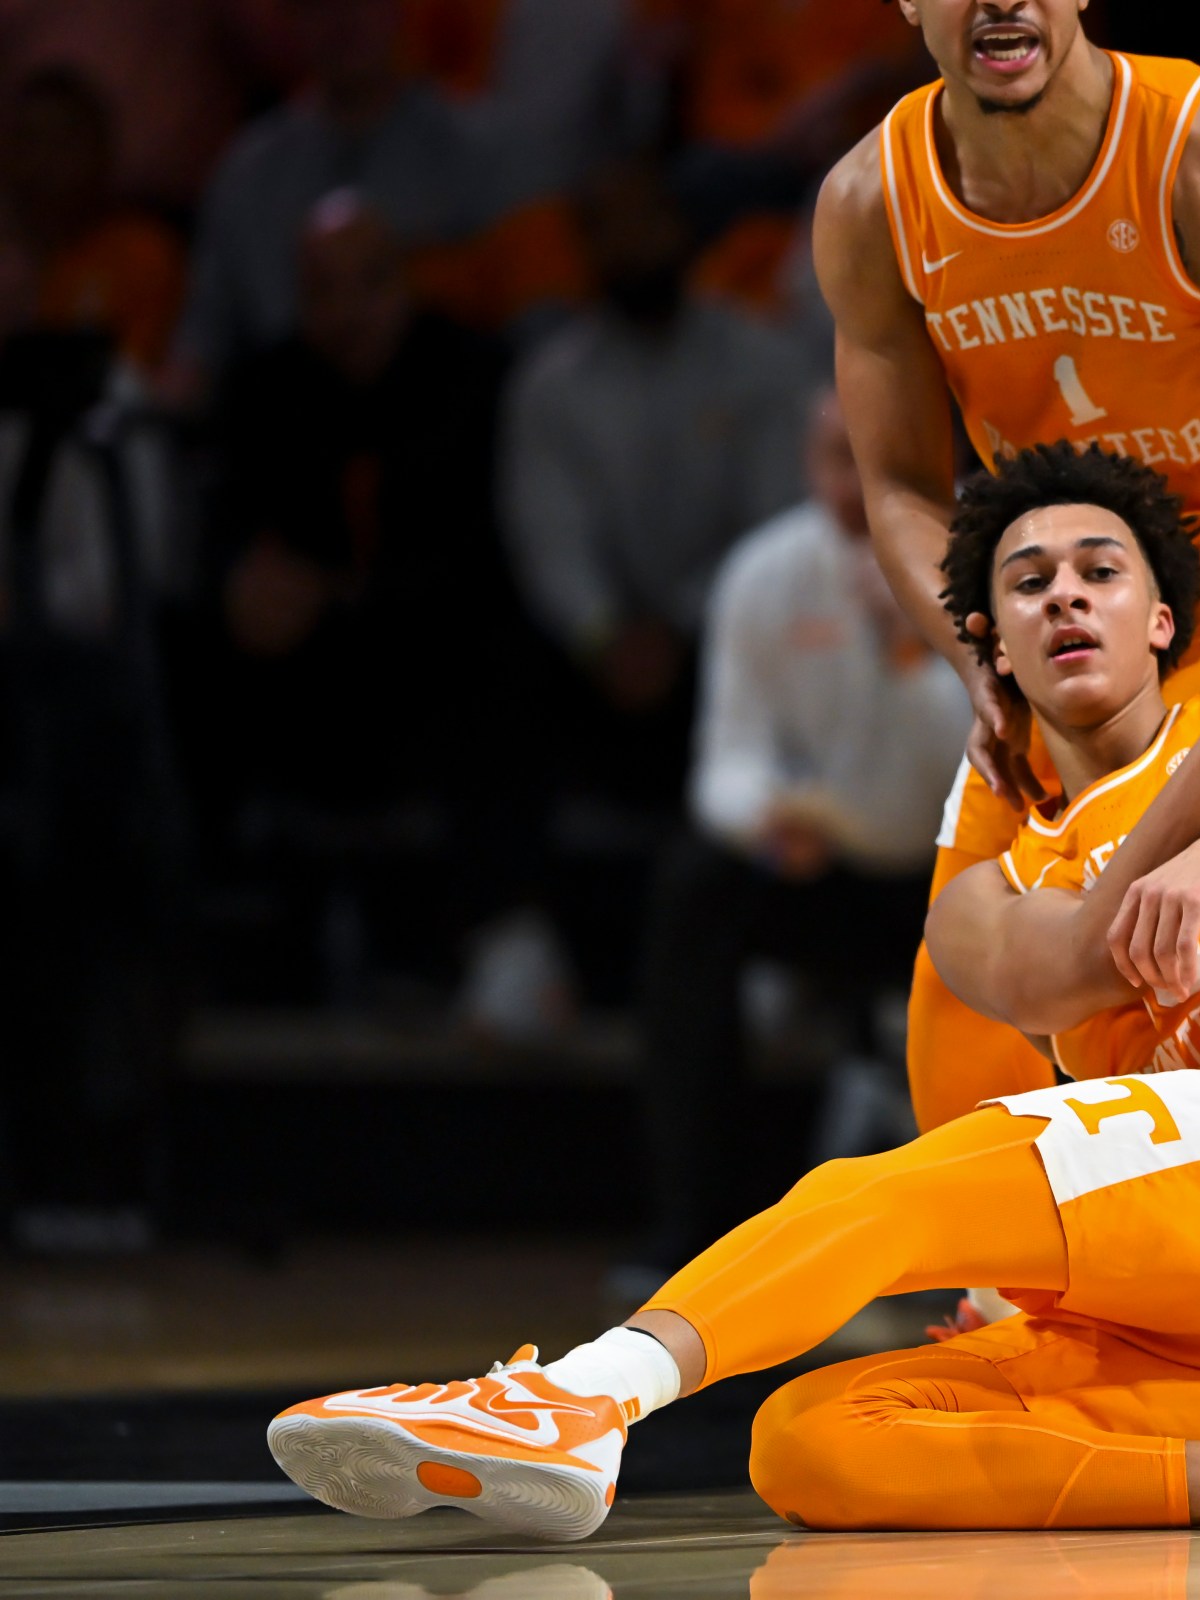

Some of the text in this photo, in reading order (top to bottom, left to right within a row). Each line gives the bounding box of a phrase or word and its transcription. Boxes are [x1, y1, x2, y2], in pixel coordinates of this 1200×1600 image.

[1109, 221, 1138, 252] SEC
[926, 286, 1175, 351] TENNESSEE
[1053, 354, 1108, 427] 1
[1062, 1077, 1182, 1145] T
